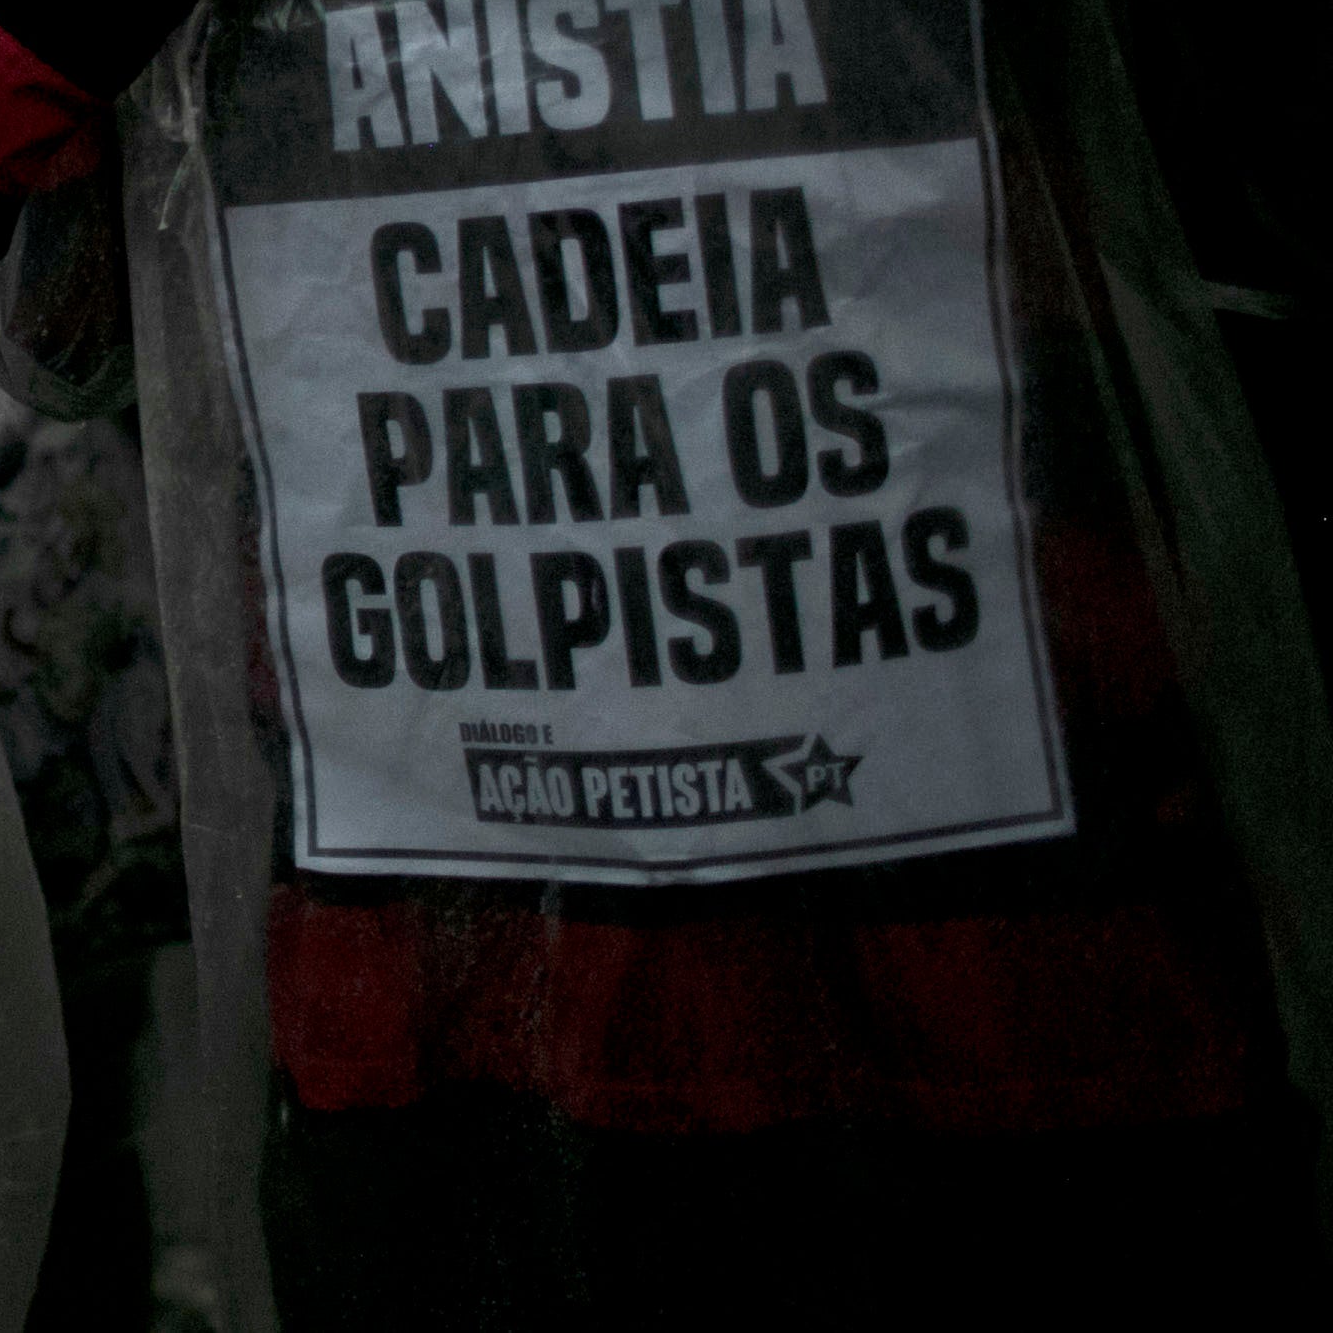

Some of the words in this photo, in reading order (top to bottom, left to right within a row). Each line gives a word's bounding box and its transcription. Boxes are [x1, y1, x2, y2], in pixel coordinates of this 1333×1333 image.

[370, 186, 832, 365] CADEIA
[356, 372, 691, 528] PARA
[721, 349, 890, 509] OS
[320, 505, 981, 691] GOLPISTAS
[458, 722, 538, 745] DIÁLOGO
[541, 724, 554, 745] E
[477, 755, 577, 823] AÇÃO
[581, 757, 755, 820] PETISTA
[806, 761, 847, 793] PT
